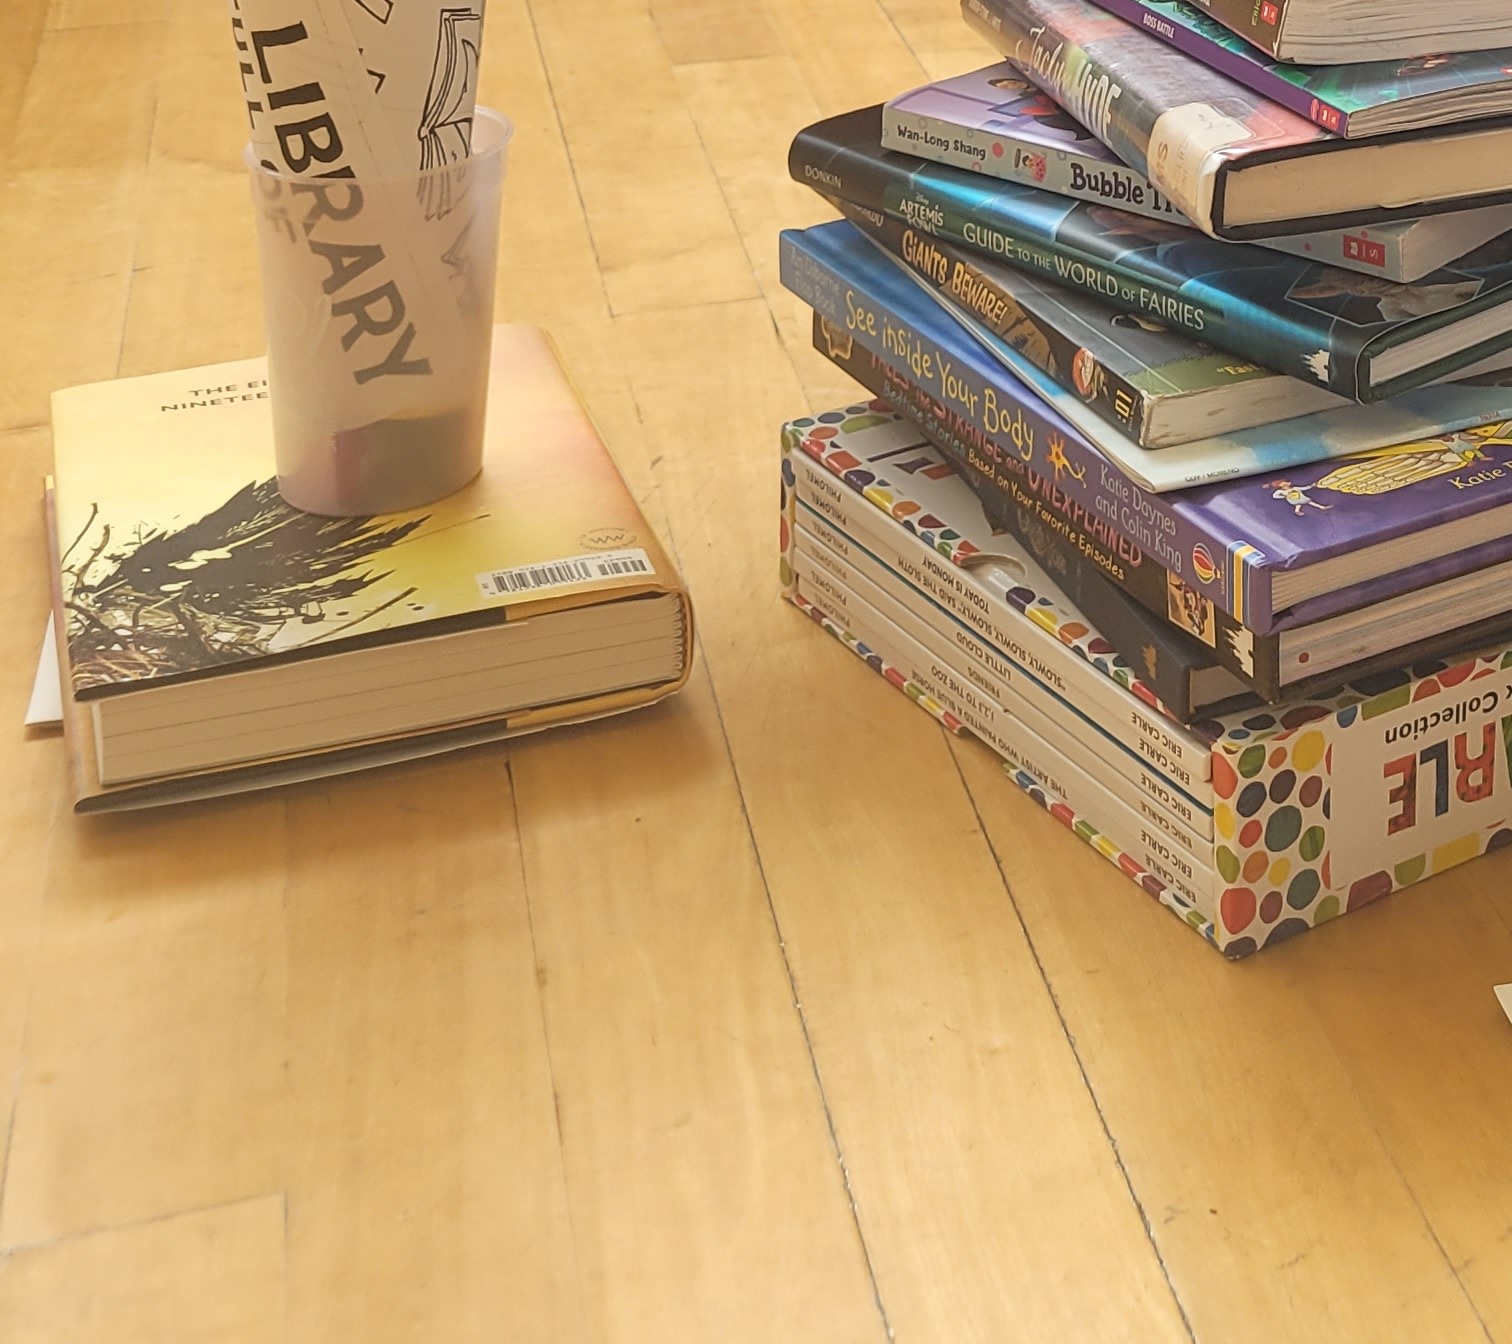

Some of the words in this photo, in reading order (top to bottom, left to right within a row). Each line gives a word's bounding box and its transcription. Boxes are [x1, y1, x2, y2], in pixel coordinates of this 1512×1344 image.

[1143, 12, 1157, 30] BOSS
[1156, 18, 1175, 39] BATTLE
[896, 124, 950, 152] Wan-Long
[952, 138, 987, 161] Shang
[804, 164, 843, 189] DONKIN
[1070, 162, 1145, 207] Bubble
[252, 20, 433, 386] LIBRARY
[906, 212, 940, 236] FOWL
[963, 222, 1015, 260] GUIDE
[1016, 247, 1031, 263] TO
[1033, 251, 1052, 271] THE
[1054, 256, 1119, 299] WORLD
[1121, 286, 1137, 303] OF
[1138, 288, 1205, 331] FAIRIES
[952, 261, 1008, 325] BEWARE!
[189, 383, 238, 397] THE
[846, 290, 877, 336] See
[882, 317, 934, 379] inside
[936, 351, 979, 417] Your
[983, 387, 1035, 462] Body
[161, 391, 269, 413] NINETEE
[805, 468, 842, 503] PHILOMEL
[1448, 459, 1506, 492] Katie
[811, 492, 847, 526] PHILOMEL
[968, 448, 995, 479] Based
[996, 472, 1010, 489] on
[1010, 478, 1033, 507] Your
[1035, 501, 1076, 542] Favorite
[1078, 536, 1125, 581] Episodes
[1100, 463, 1127, 505] Katie
[1129, 480, 1178, 538] Daynes
[1095, 494, 1118, 524] and
[1119, 505, 1150, 548] Colin
[1152, 533, 1184, 574] King
[898, 556, 924, 584] SLOTH
[921, 555, 955, 588] MONDAY
[922, 575, 938, 595] THE
[939, 587, 957, 611] SAID
[963, 589, 990, 615] TODAY
[956, 631, 985, 658] CLOUD
[930, 665, 949, 685] ZOO
[984, 649, 1012, 681] LITTLE
[948, 679, 968, 698] THE
[967, 666, 1001, 699] FRIENDS
[1131, 711, 1160, 740] CARLE
[1383, 690, 1499, 746] Collection
[1138, 737, 1168, 767] CARLE
[1161, 732, 1183, 758] ERIC
[1021, 757, 1050, 785] ARTIST
[1169, 759, 1191, 786] ERIC
[1050, 780, 1069, 800] THE
[1140, 772, 1170, 802] CARLE
[1171, 793, 1192, 822] ERIC
